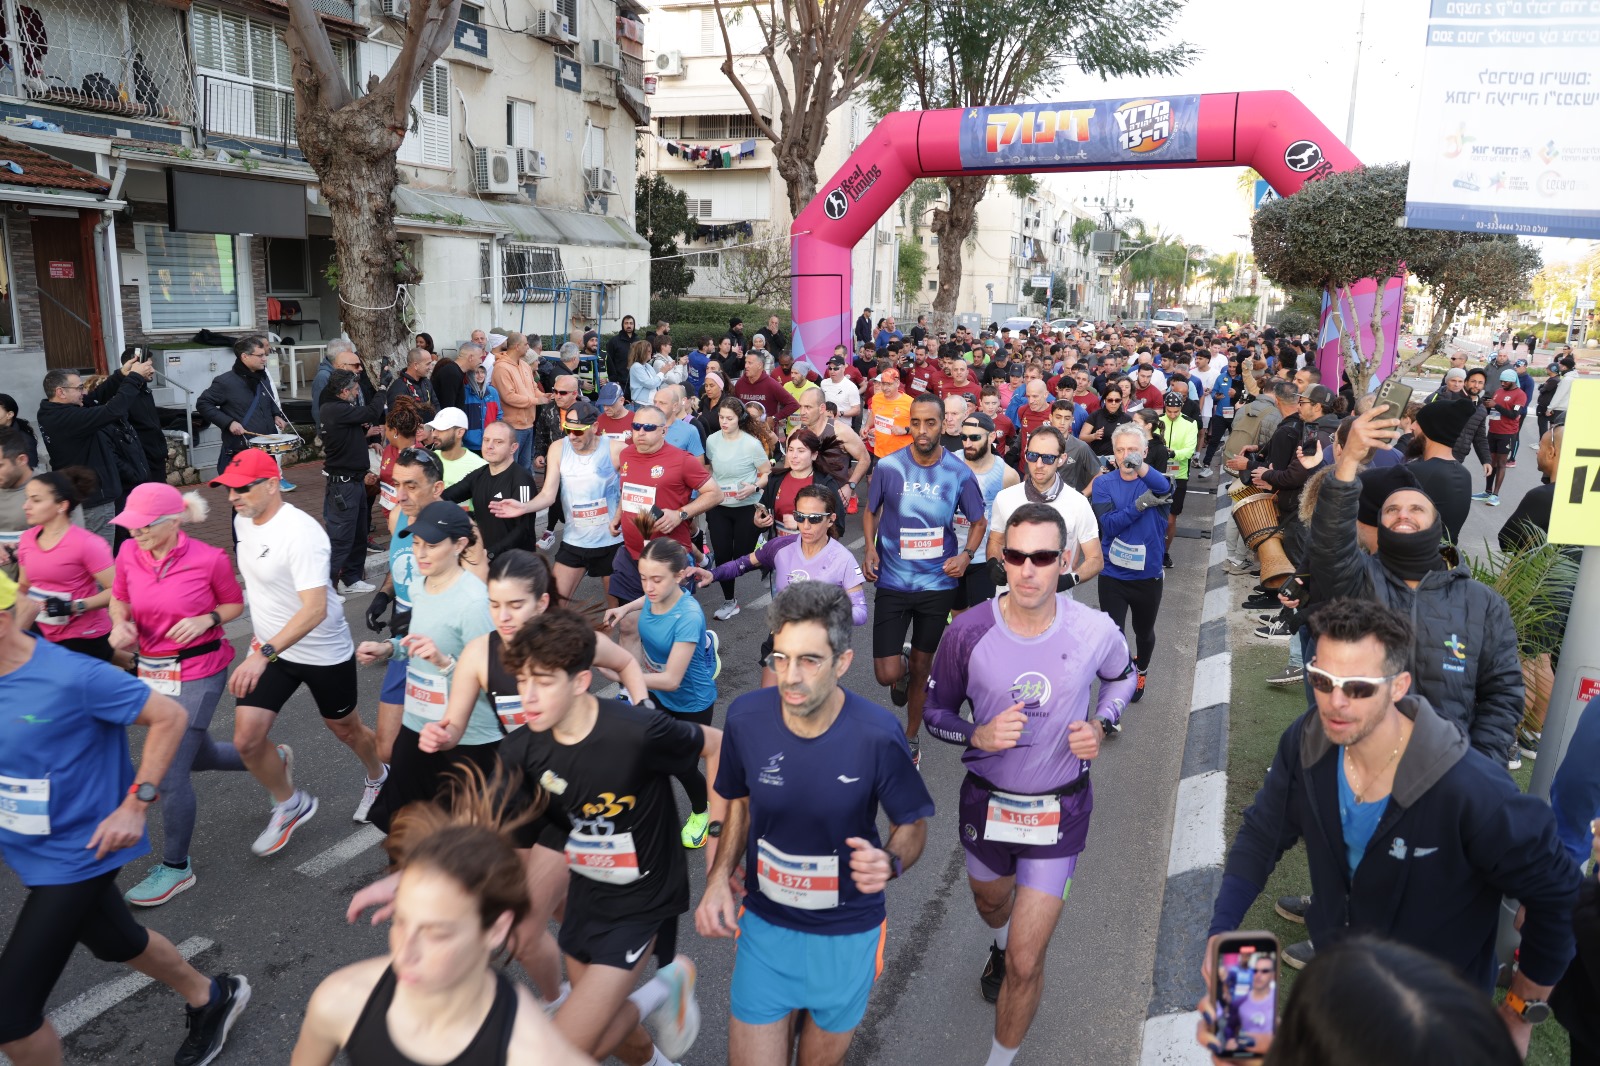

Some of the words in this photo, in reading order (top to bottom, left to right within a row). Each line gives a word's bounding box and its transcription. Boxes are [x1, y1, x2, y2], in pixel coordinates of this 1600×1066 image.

[1113, 100, 1170, 132] מרוץ
[1155, 113, 1169, 122] אור
[986, 107, 1097, 153] זינוק
[1129, 119, 1153, 130] יהודה
[840, 164, 863, 192] Real
[846, 164, 882, 201] Timing
[582, 510, 597, 518] 1187
[913, 540, 932, 548] 1049
[1009, 813, 1039, 826] 1166
[776, 872, 812, 889] 1374
